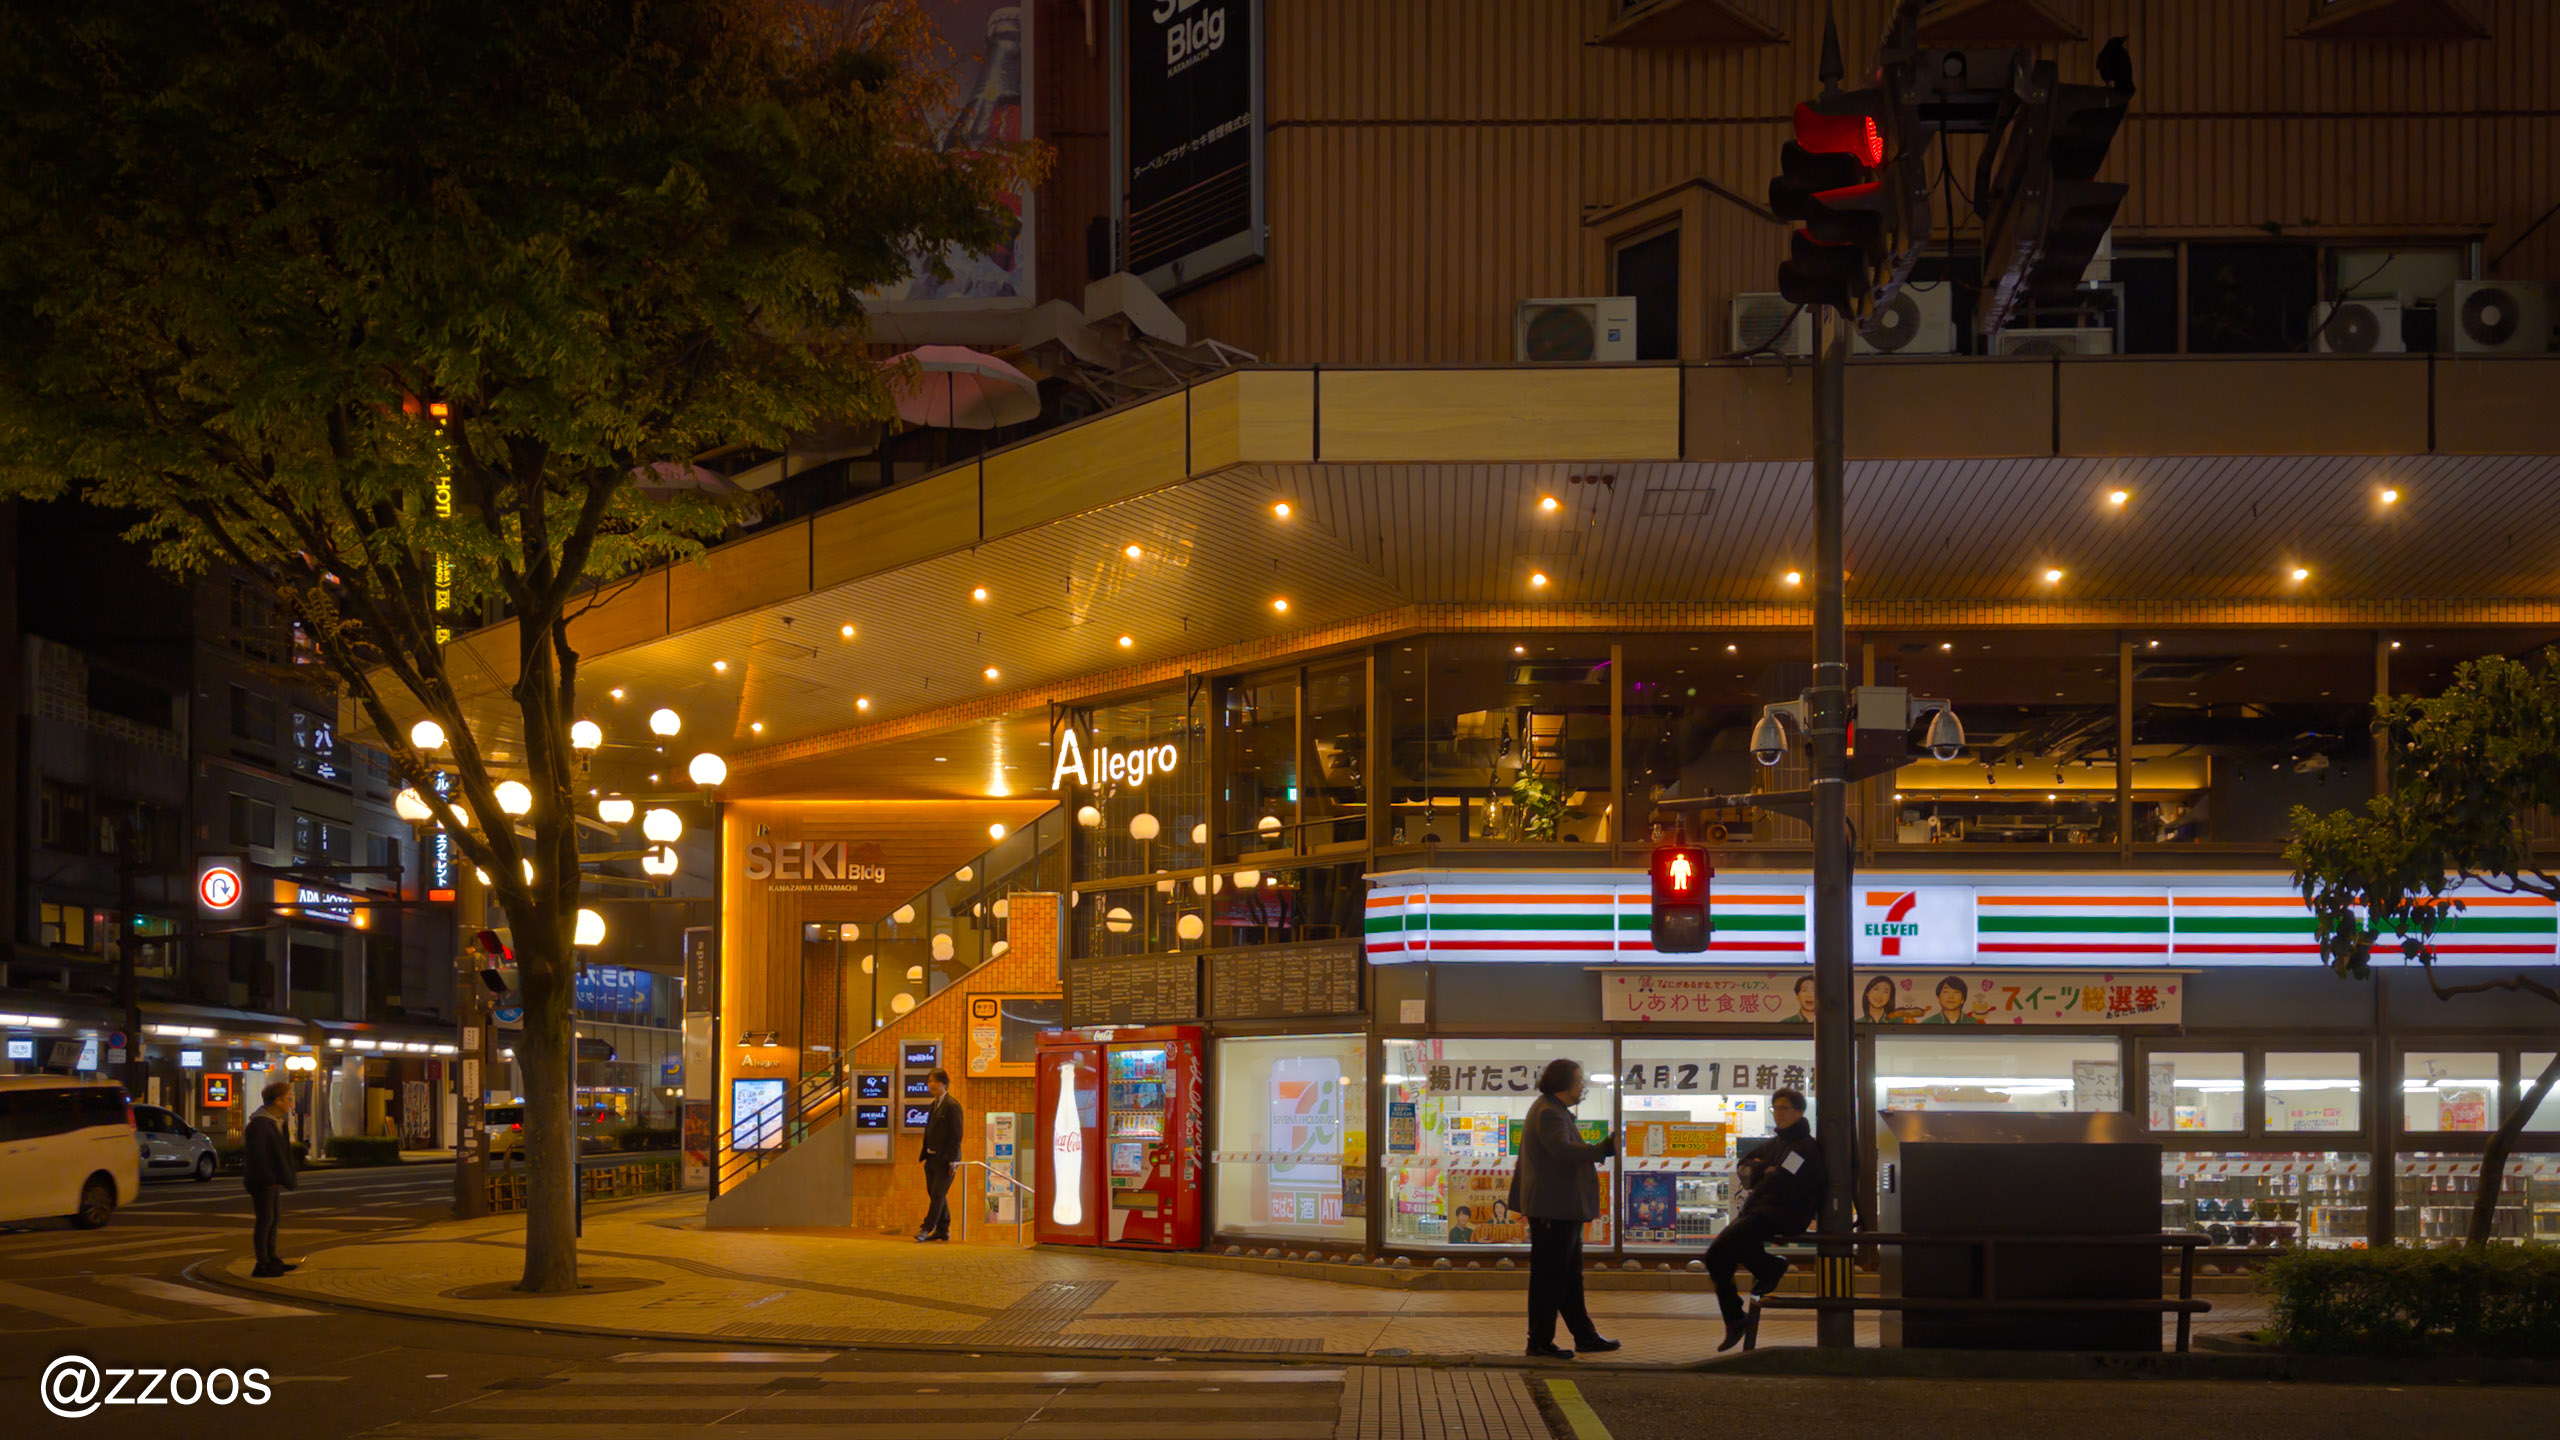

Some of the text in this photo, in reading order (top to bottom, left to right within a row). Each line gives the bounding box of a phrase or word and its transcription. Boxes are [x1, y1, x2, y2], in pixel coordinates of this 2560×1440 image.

[1167, 7, 1226, 65] Bldg
[1167, 49, 1210, 79] KATAMACHI
[1052, 729, 1177, 790] Allegro
[744, 841, 886, 883] SEKI Bldg
[696, 941, 706, 994] spazio
[2002, 985, 2158, 1012] スイーツ総選挙
[1429, 1065, 1543, 1091] 揚げたこ
[1272, 1200, 1294, 1217] たばこ
[1300, 1199, 1315, 1219] 酒
